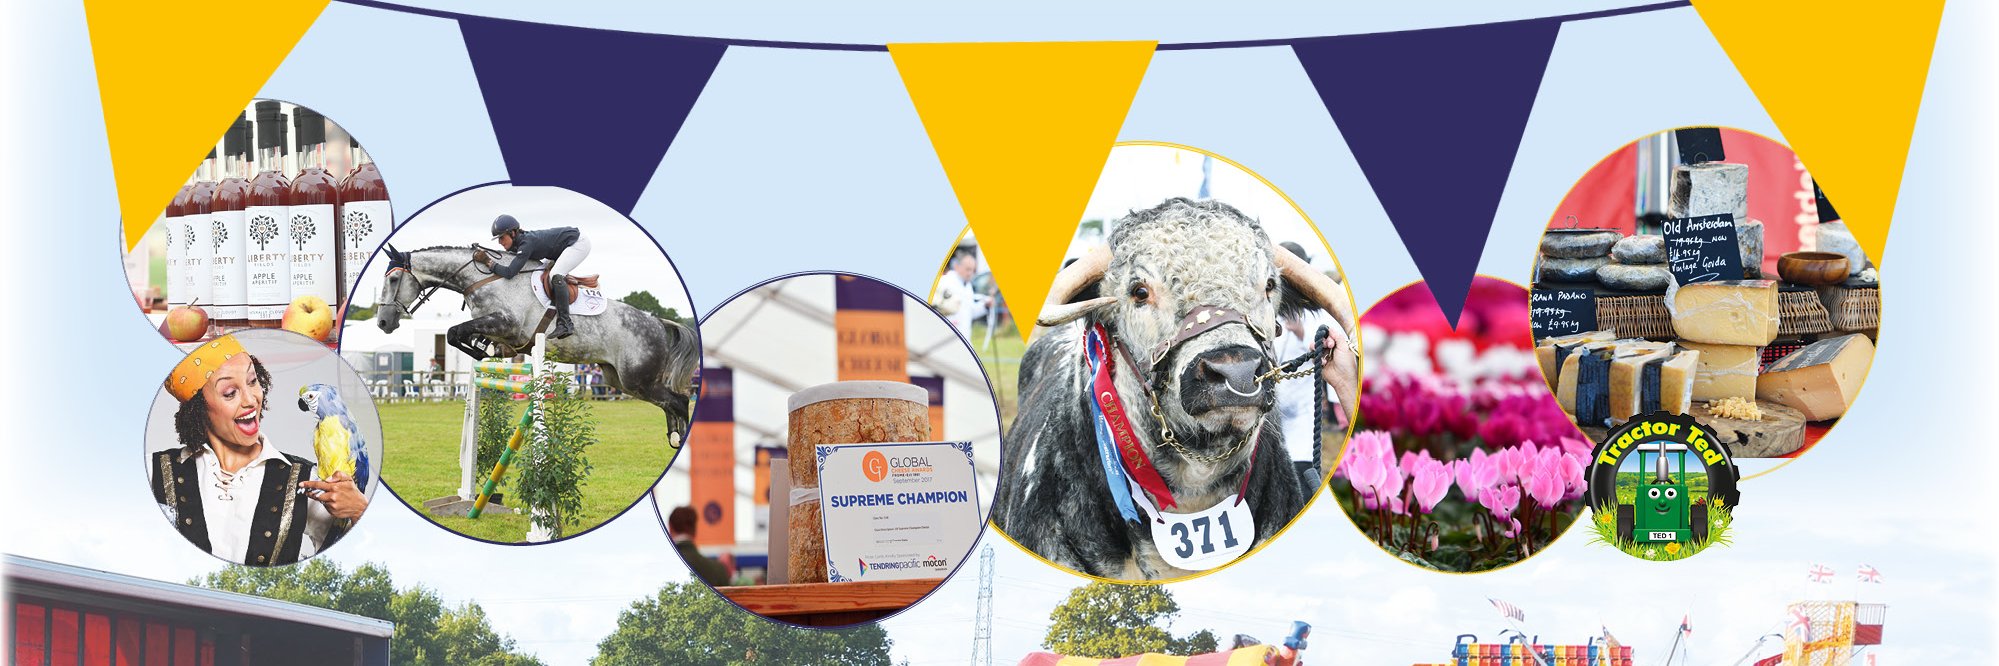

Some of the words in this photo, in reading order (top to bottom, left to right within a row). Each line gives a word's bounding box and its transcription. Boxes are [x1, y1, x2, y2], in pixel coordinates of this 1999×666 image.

[1663, 219, 1681, 235] Old
[247, 253, 286, 263] LIBERTY
[253, 272, 276, 280] APPLE
[293, 273, 313, 281] APPLE
[1532, 293, 1553, 302] RANA
[1557, 291, 1587, 301] PADANO
[1101, 391, 1147, 470] CHAMPION
[890, 456, 932, 468] GLOBAL
[831, 494, 894, 507] SUPREME
[897, 491, 967, 505] CHAMPION
[1170, 510, 1239, 559] 371
[923, 559, 947, 567] mocon
